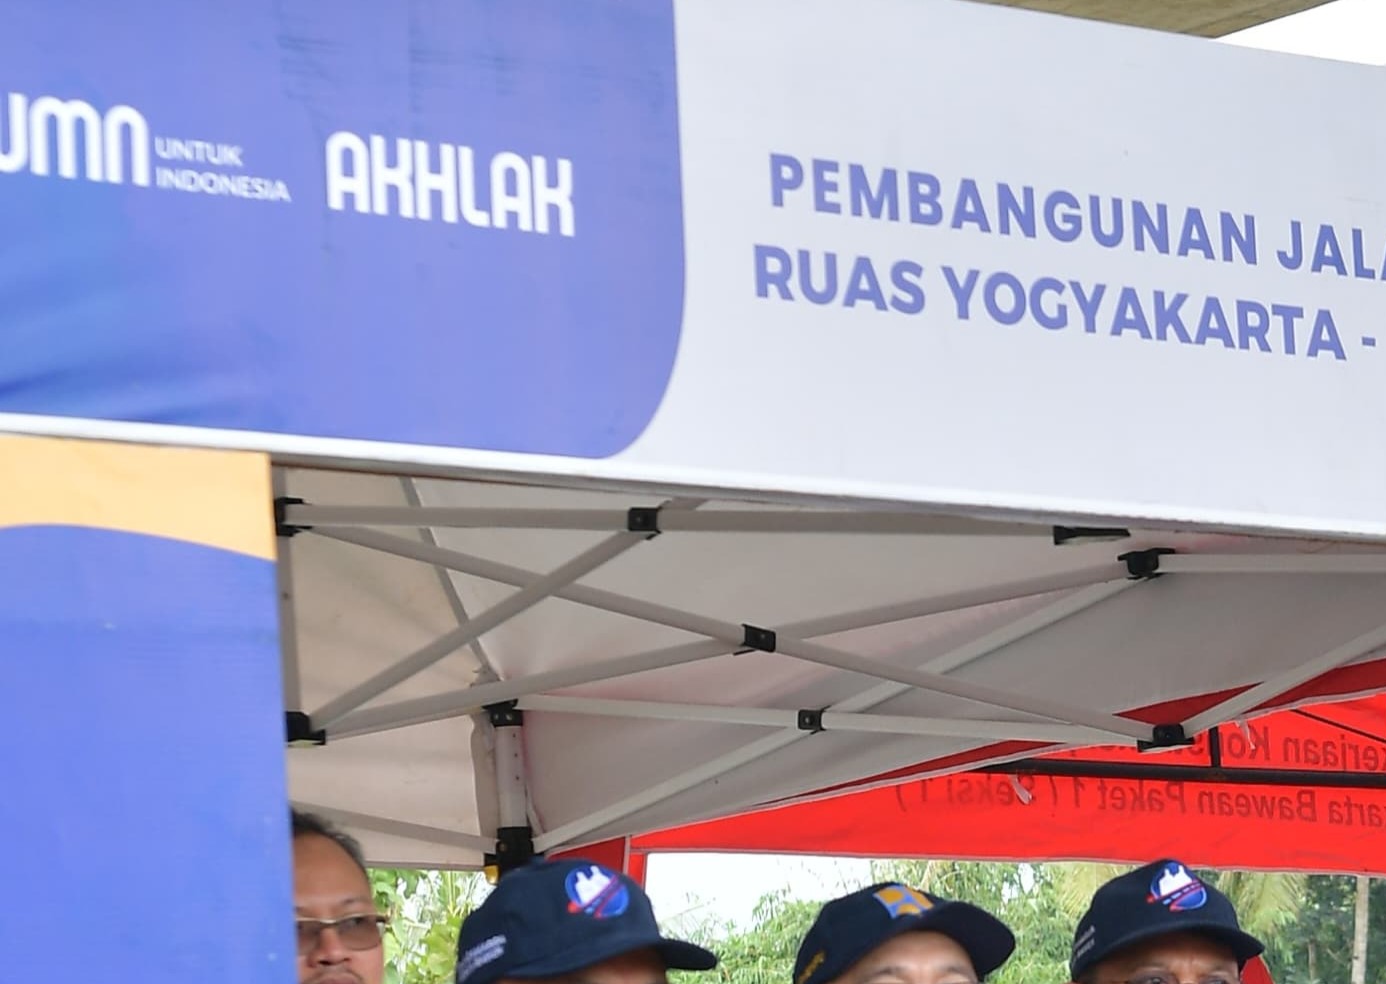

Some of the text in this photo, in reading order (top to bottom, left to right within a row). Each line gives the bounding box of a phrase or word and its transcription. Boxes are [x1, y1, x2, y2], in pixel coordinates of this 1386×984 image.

[155, 136, 244, 167] UNTUK
[155, 166, 293, 202] INDONESIA
[325, 131, 576, 237] AKHLAK
[769, 152, 1258, 266] PEMBANGUNAN
[754, 244, 925, 315] RUAS
[941, 265, 1347, 361] YOGYAKARTA
